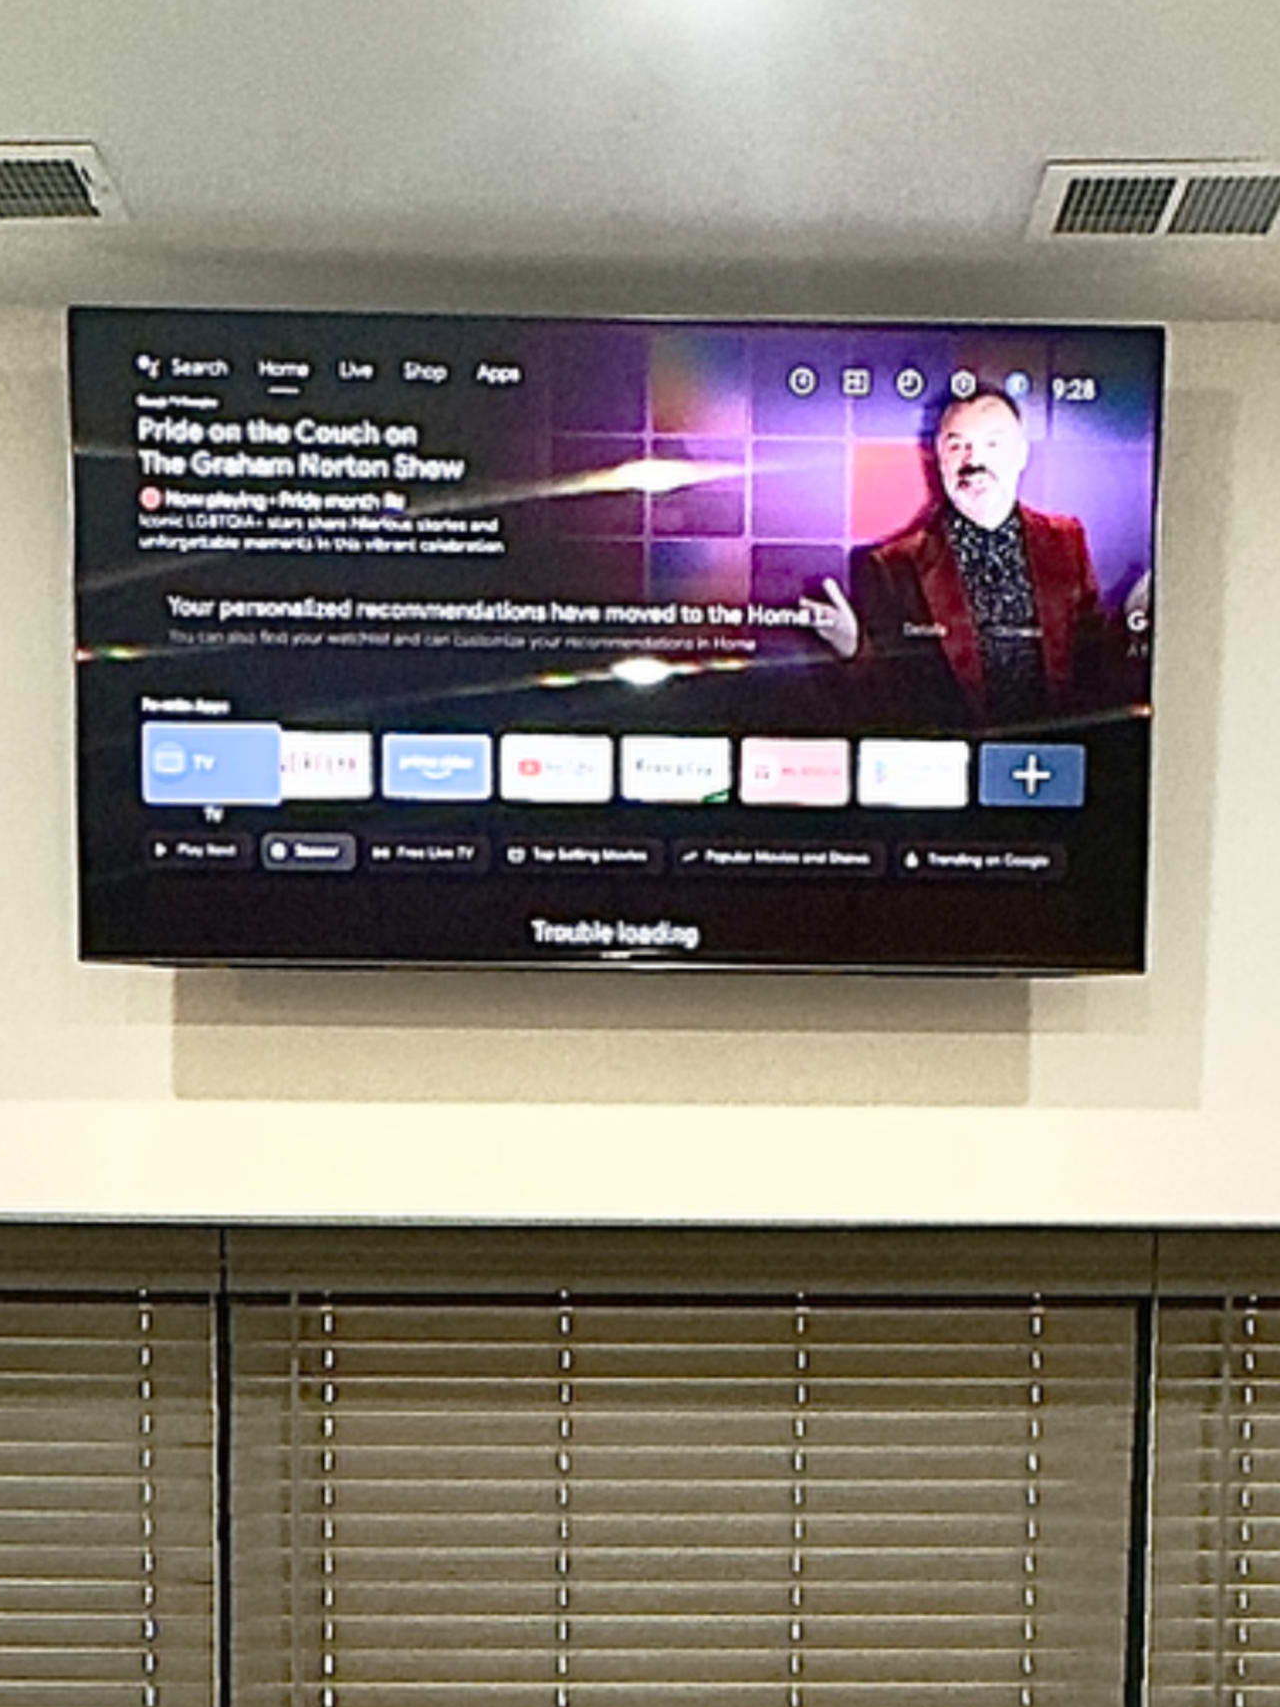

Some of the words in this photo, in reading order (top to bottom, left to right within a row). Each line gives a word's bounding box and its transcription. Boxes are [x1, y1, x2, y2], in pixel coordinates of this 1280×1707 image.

[172, 357, 229, 376] Search
[259, 358, 310, 378] Home
[338, 360, 374, 380] Live
[403, 360, 448, 383] Shop
[476, 363, 521, 384] Apps
[1052, 378, 1096, 400] 9:28
[138, 415, 205, 444] Pride
[208, 422, 241, 443] on
[246, 418, 292, 445] the
[294, 418, 380, 447] Couch
[385, 425, 418, 446] on
[138, 449, 187, 475] The
[190, 449, 294, 478] Graham
[298, 452, 390, 479] Norton
[393, 453, 465, 481] Show
[166, 490, 204, 508] Now
[206, 490, 267, 512] playing
[279, 490, 322, 511] Pride
[324, 492, 381, 511] month
[167, 595, 215, 618] Your
[220, 596, 353, 621] personalized
[356, 599, 546, 623] recommendations
[551, 601, 600, 624] have
[605, 603, 678, 625] moved
[680, 604, 704, 625] to
[707, 604, 743, 625] the
[747, 605, 810, 626] Home
[259, 629, 289, 645] find
[192, 754, 216, 771] TV
[531, 918, 614, 945] Trouble
[616, 919, 700, 950] loading
